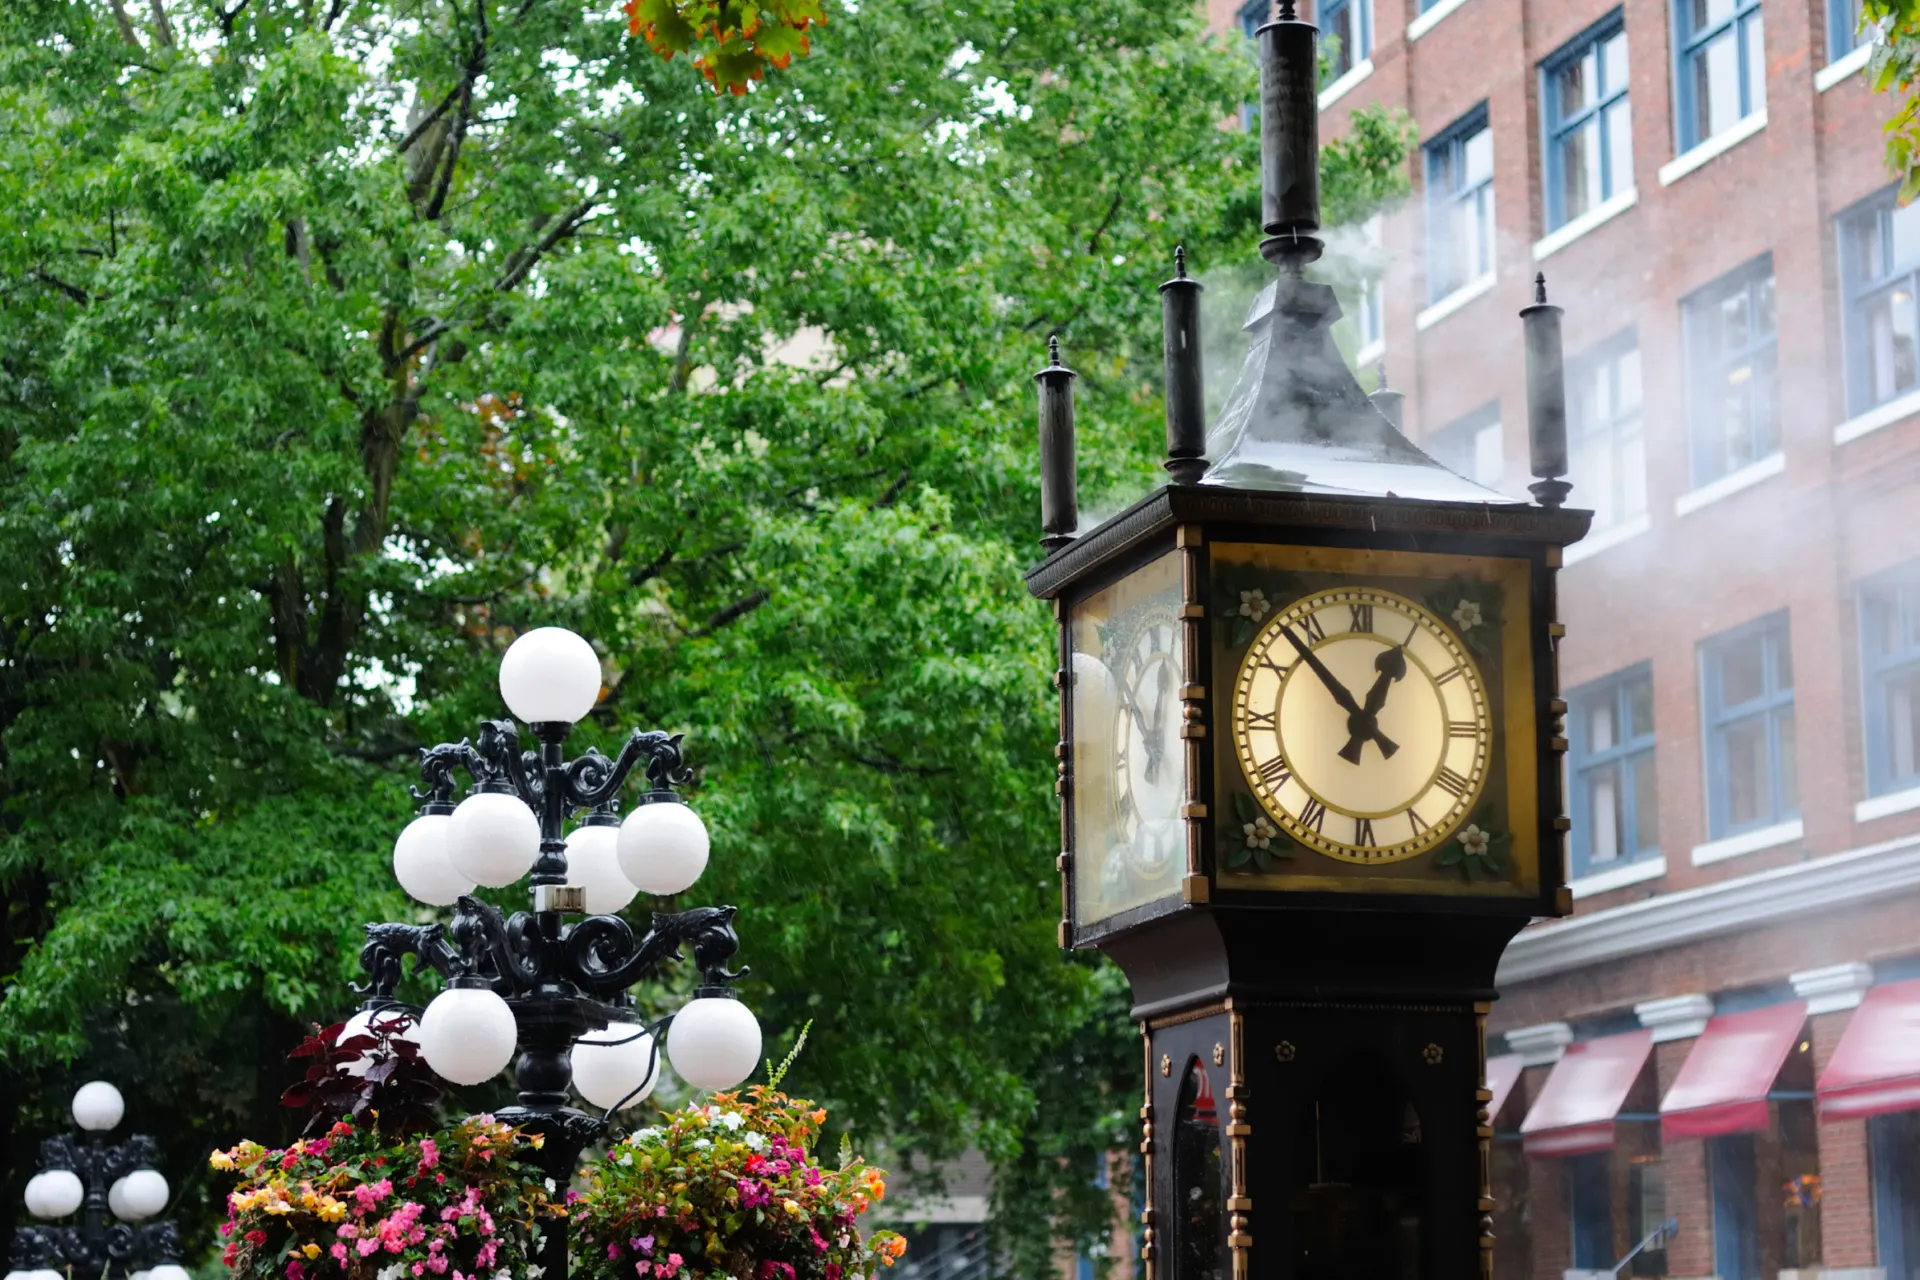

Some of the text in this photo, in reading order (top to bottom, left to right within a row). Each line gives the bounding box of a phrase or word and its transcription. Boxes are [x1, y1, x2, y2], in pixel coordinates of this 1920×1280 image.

[1297, 613, 1326, 647] XI
[1349, 604, 1373, 633] XII
[1403, 622, 1419, 648] I
[1258, 653, 1290, 681] X
[1435, 665, 1461, 686] II
[1248, 710, 1276, 731] IX
[1449, 720, 1477, 738] III
[1258, 755, 1292, 794] VIII
[1434, 766, 1467, 798] IIII
[1299, 796, 1326, 834] VII
[1407, 806, 1431, 836] V
[1355, 819, 1376, 848] VI
